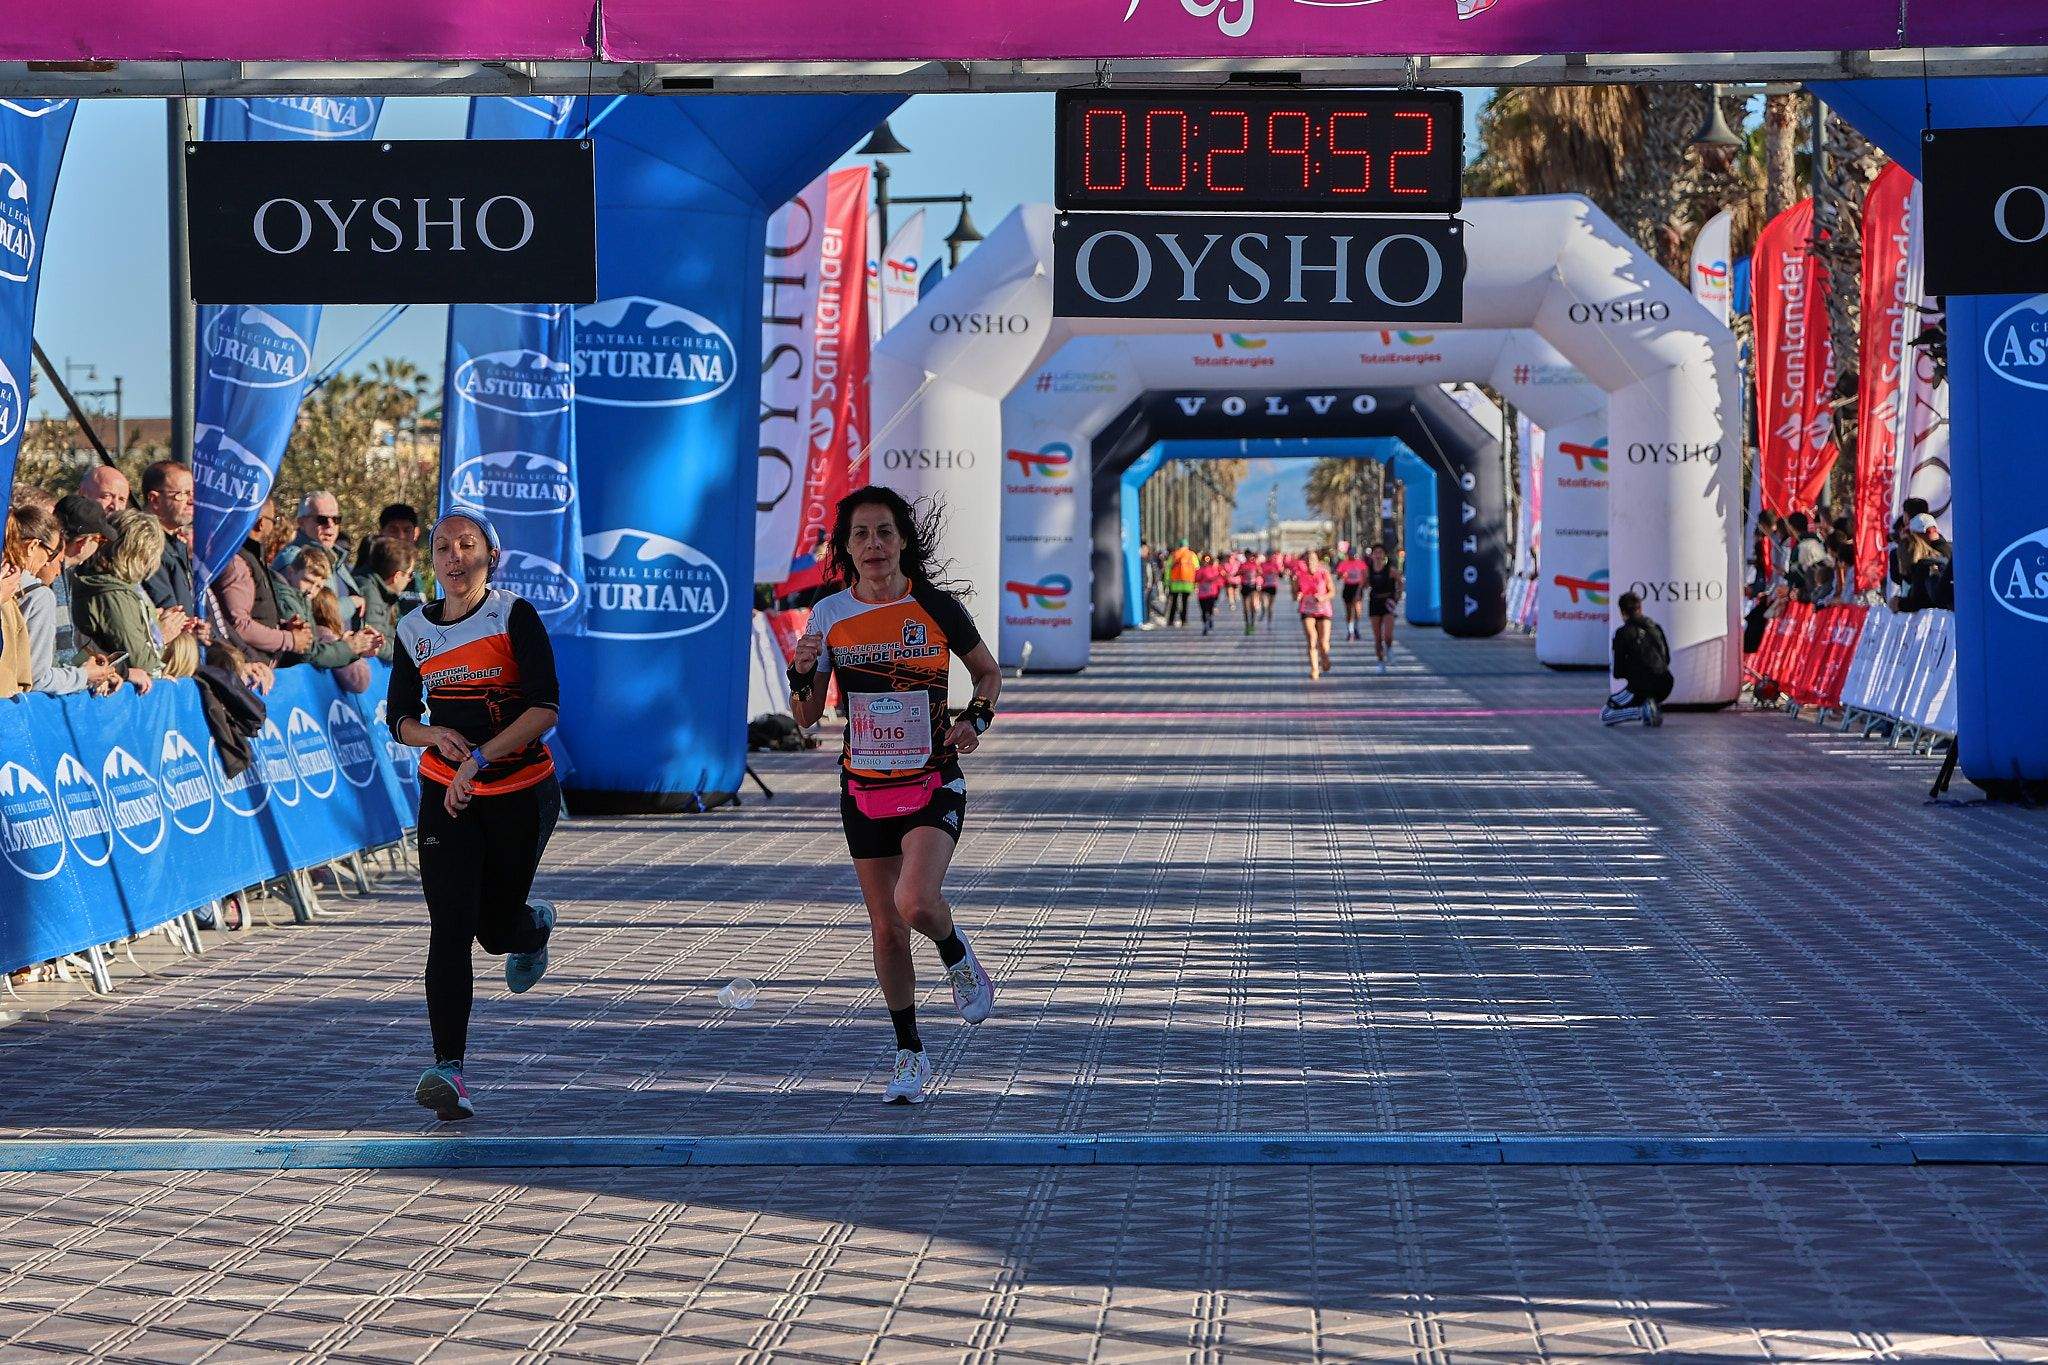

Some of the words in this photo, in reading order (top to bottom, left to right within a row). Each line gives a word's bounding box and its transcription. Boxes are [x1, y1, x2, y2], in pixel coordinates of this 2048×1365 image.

[1084, 109, 1434, 194] 00:29:52
[253, 195, 535, 254] OYSHO
[1075, 230, 1443, 308] OYSHO
[1568, 300, 1670, 324] OYSHO
[929, 313, 1029, 335] OYSHO
[1780, 251, 1805, 409] Santander
[652, 335, 721, 351] LECHERA
[1193, 355, 1275, 368] TotalEnergies
[1359, 352, 1442, 365] TotalEnergies
[1174, 394, 1378, 417] VOLVO
[882, 447, 976, 471] OYSHO
[1627, 441, 1723, 465] OYSHO
[1006, 486, 1073, 496] TotalEnergies
[1460, 471, 1479, 619] VOLVO
[1630, 581, 1723, 602] OYSHO
[1006, 615, 1073, 627] TotalEnergies
[870, 650, 890, 663] DE
[893, 646, 942, 661] POBLET
[463, 666, 503, 681] POBLET
